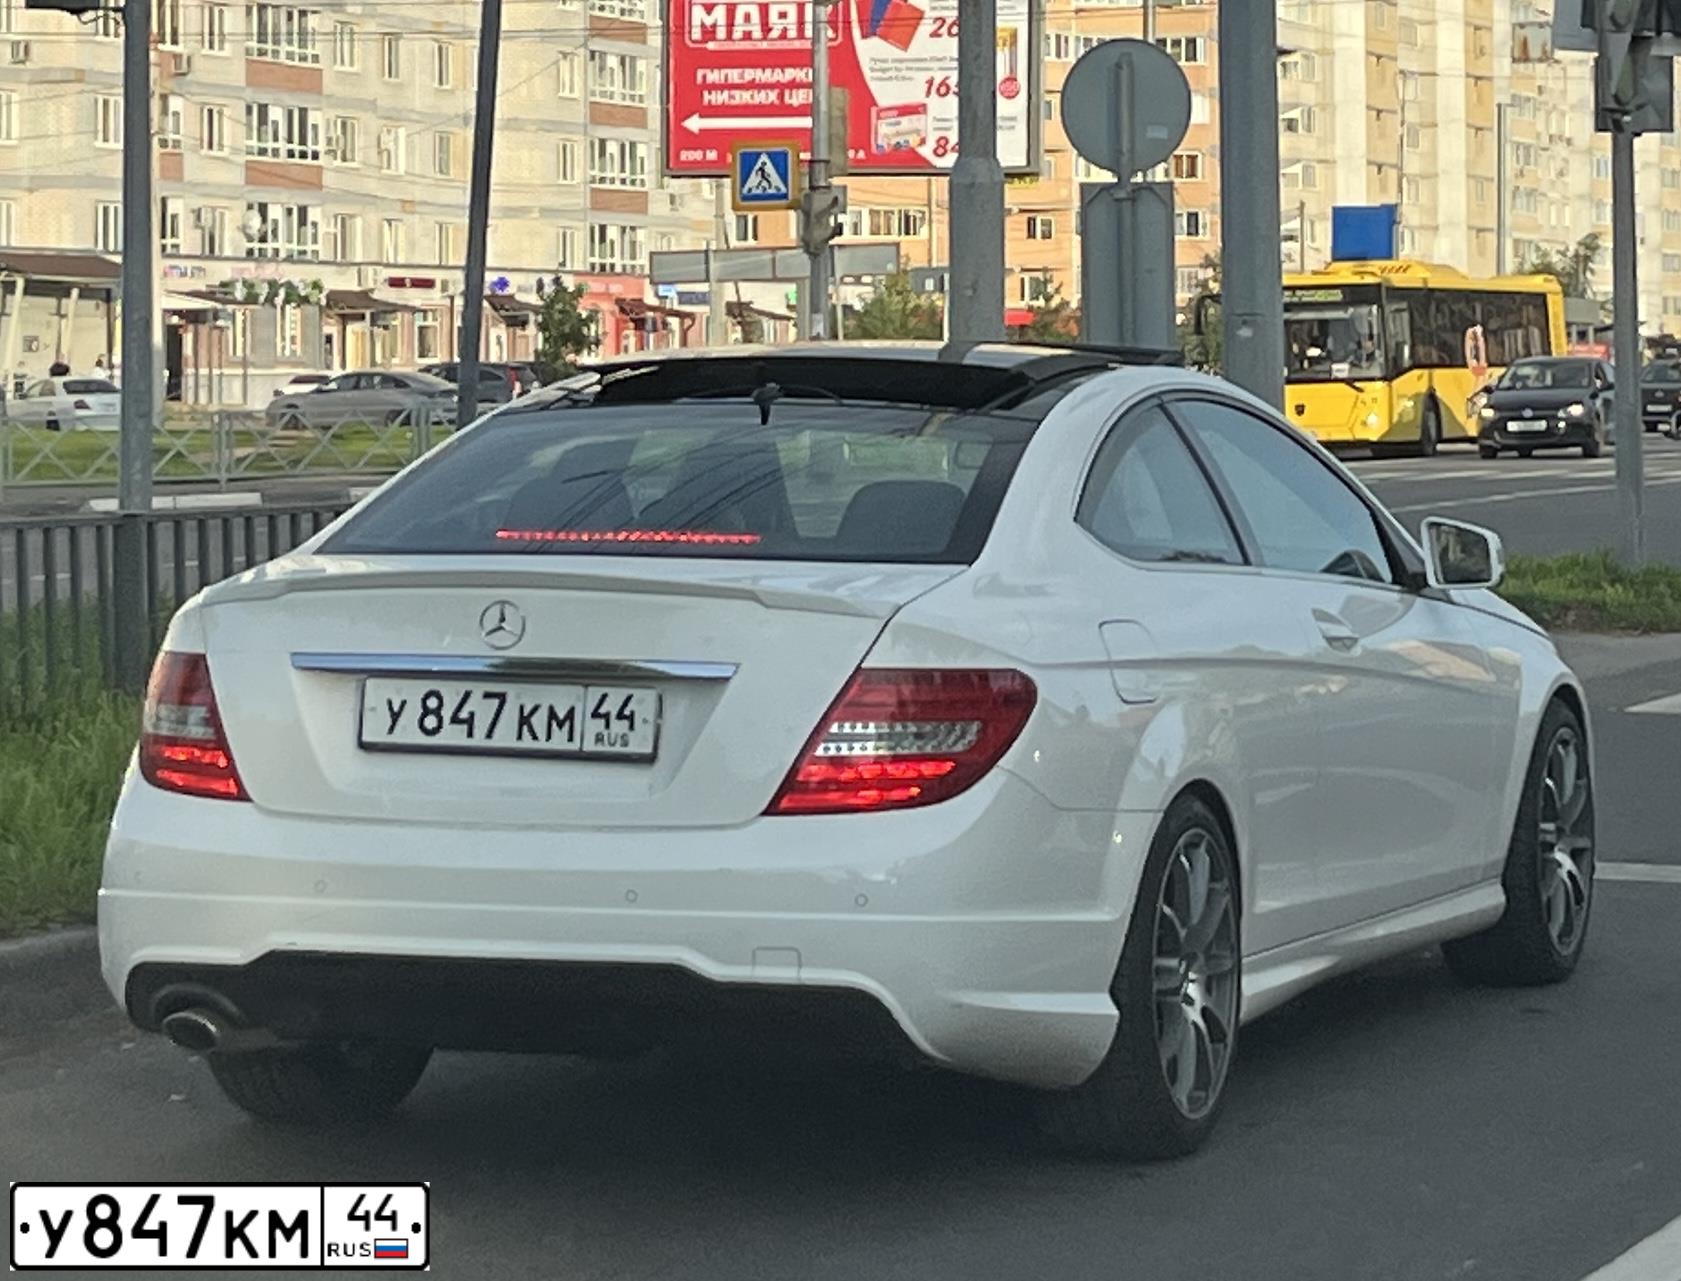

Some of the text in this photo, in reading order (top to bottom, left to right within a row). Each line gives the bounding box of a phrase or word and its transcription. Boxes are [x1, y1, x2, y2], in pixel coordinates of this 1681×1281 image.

[691, 3, 836, 40] МАЯК
[696, 67, 813, 85] ГИПЕРМАРК
[702, 88, 780, 106] НИЗКИХ
[590, 692, 636, 731] 44
[594, 733, 630, 748] RUS
